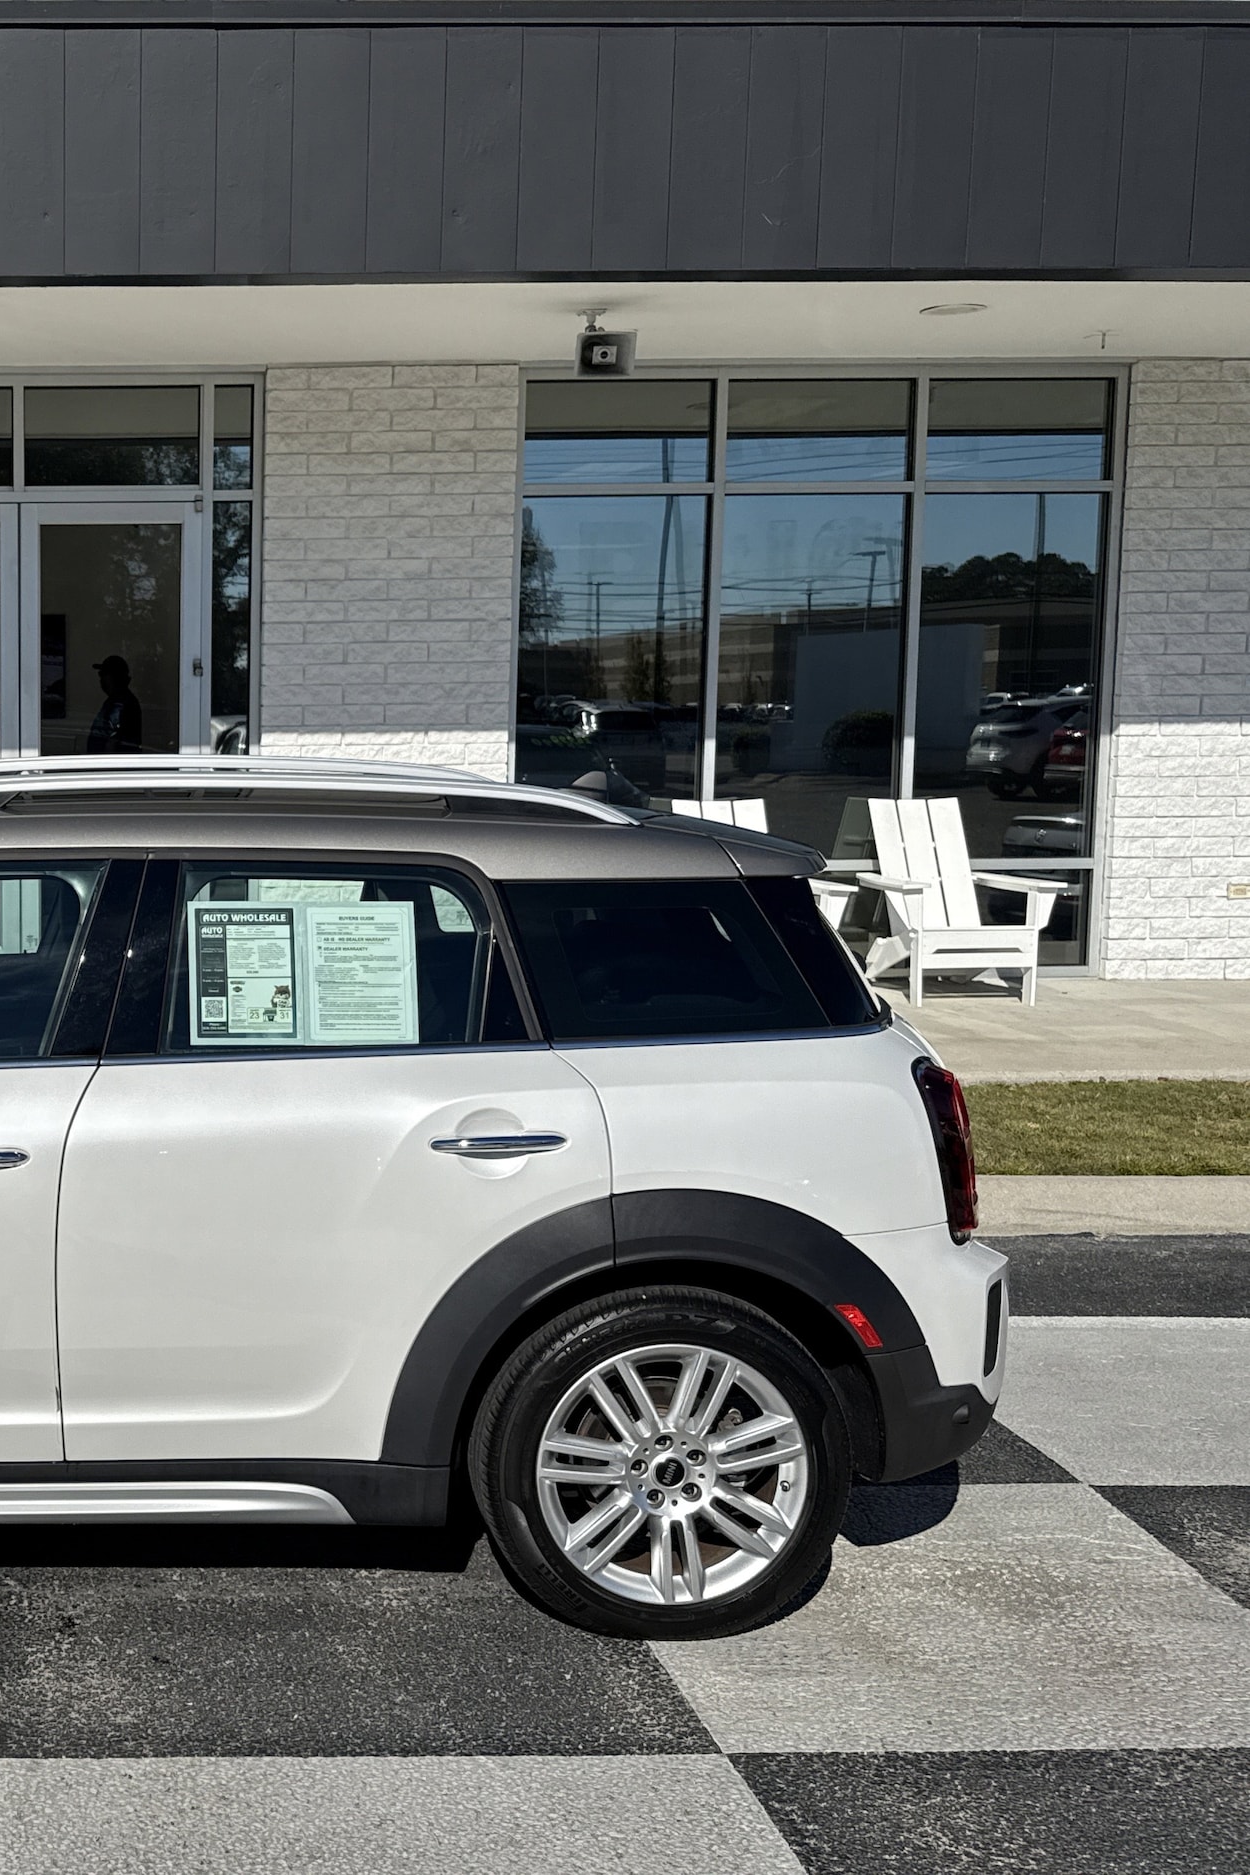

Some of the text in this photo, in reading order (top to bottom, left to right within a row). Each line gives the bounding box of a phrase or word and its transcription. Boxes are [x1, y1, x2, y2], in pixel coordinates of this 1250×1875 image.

[202, 913, 287, 922] AUTO WHOLESALE
[201, 926, 223, 934] AUTO
[662, 1462, 678, 1484] MINI
